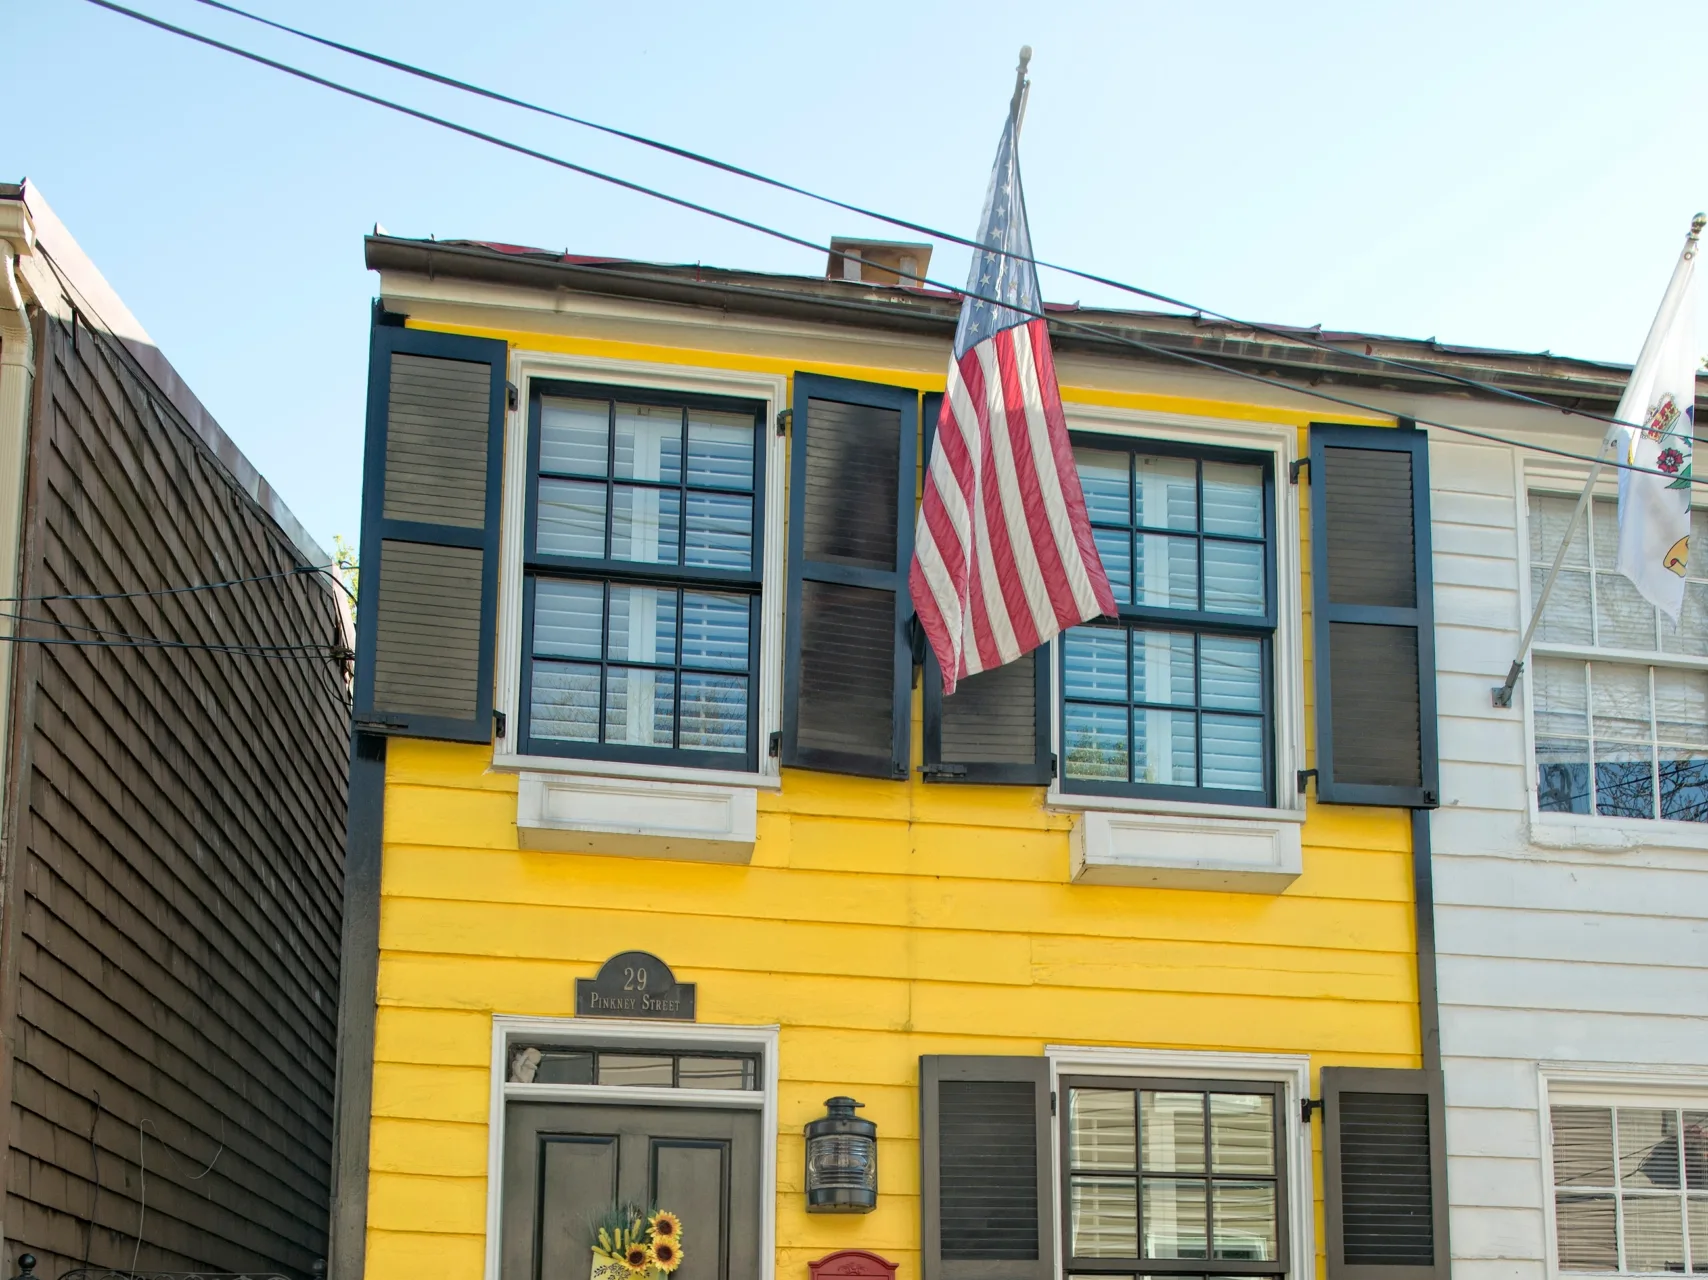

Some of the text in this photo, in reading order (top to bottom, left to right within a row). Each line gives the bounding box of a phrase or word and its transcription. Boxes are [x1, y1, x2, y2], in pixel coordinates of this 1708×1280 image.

[623, 967, 647, 991] 29
[590, 991, 681, 1012] PINKNEY STREET
